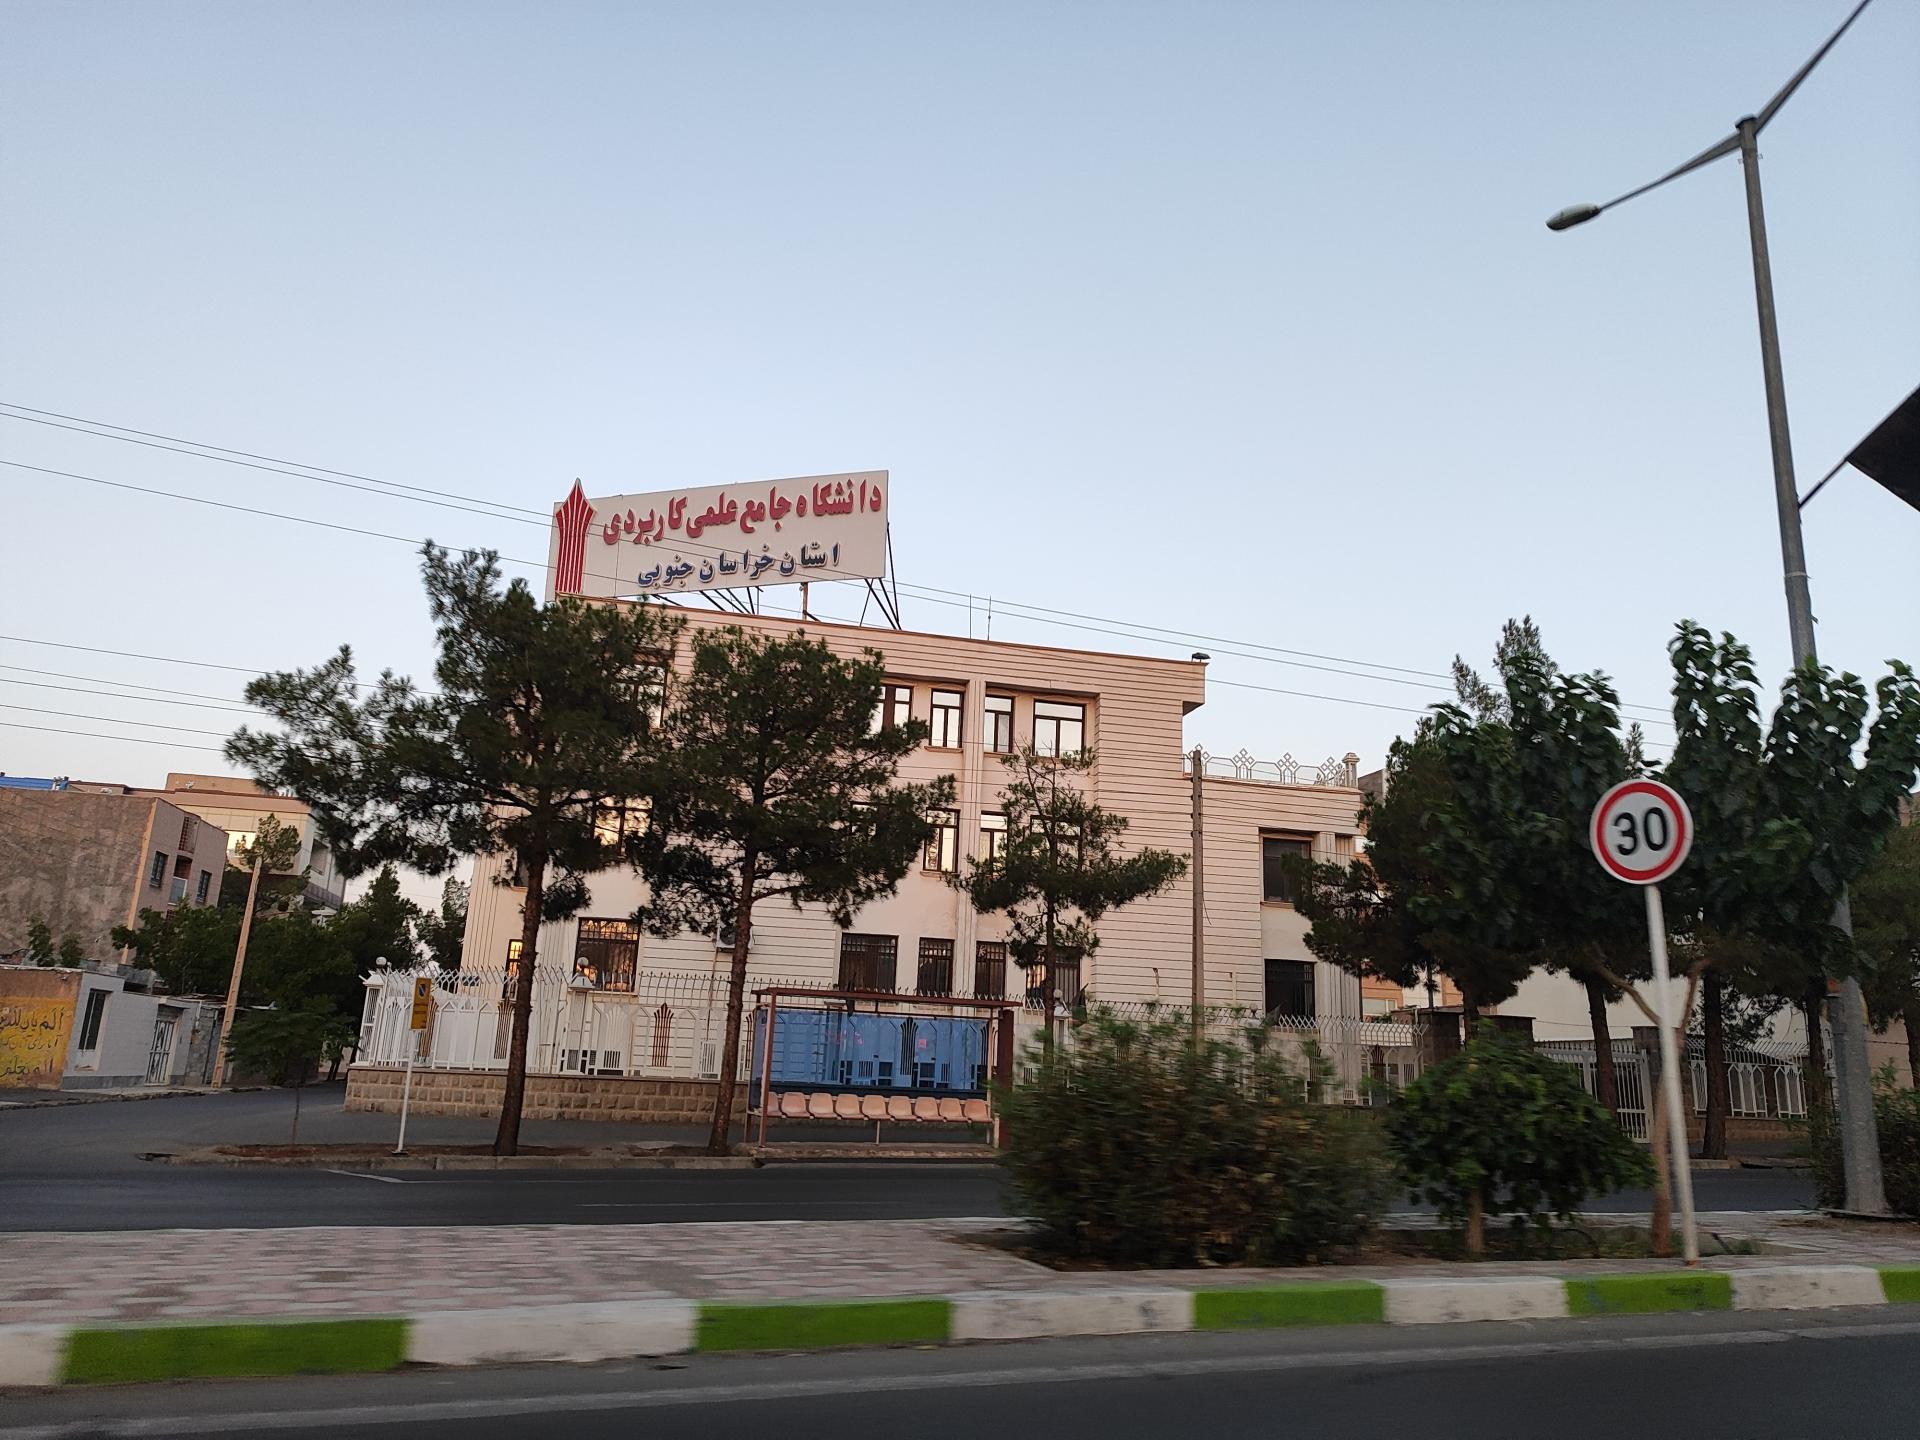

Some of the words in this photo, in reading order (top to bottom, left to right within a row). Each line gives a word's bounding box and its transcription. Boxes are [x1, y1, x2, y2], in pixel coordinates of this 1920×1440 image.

[686, 491, 738, 538] علمی
[740, 486, 792, 533] جامع
[796, 478, 882, 518] دانشگاه
[602, 496, 688, 545] کاربردی
[637, 553, 695, 588] جنوبی
[699, 543, 775, 583] خراسان
[779, 541, 840, 576] استان
[1614, 807, 1668, 856] 30
